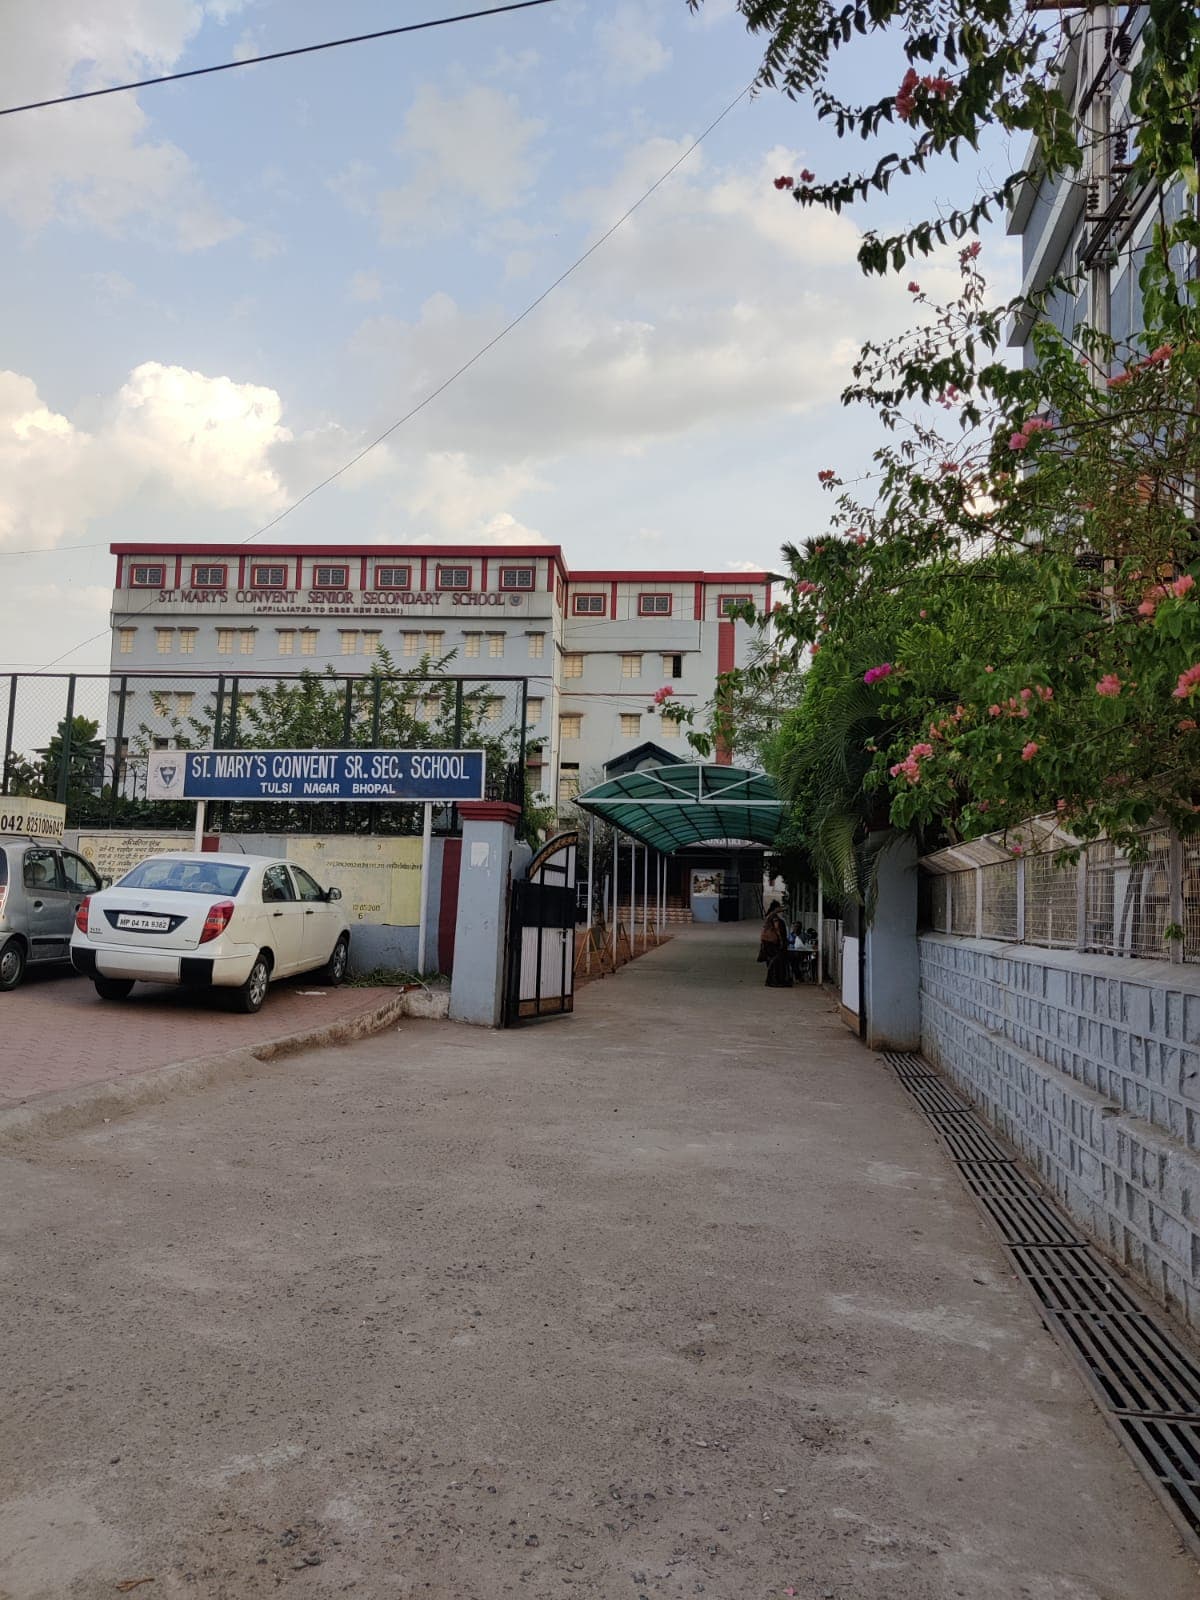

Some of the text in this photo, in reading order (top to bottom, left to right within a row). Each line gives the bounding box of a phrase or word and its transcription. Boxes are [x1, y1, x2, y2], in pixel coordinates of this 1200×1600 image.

[158, 590, 177, 603] ST.
[181, 590, 228, 603] MARY'S
[235, 591, 298, 604] CONVENT
[307, 591, 354, 604] SENIOR
[363, 592, 443, 605] SECONDARY
[452, 593, 505, 606] SCHOOL
[192, 756, 211, 778] ST.
[215, 755, 267, 778] MARY'S
[272, 755, 338, 779] CONVENT
[344, 755, 368, 779] SR.
[371, 755, 403, 779] SEC.
[410, 756, 470, 779] SCHOOL
[260, 782, 396, 794] TULSI NAGAR BHOPAL
[26, 815, 64, 836] 8251006042
[131, 919, 139, 927] 04
